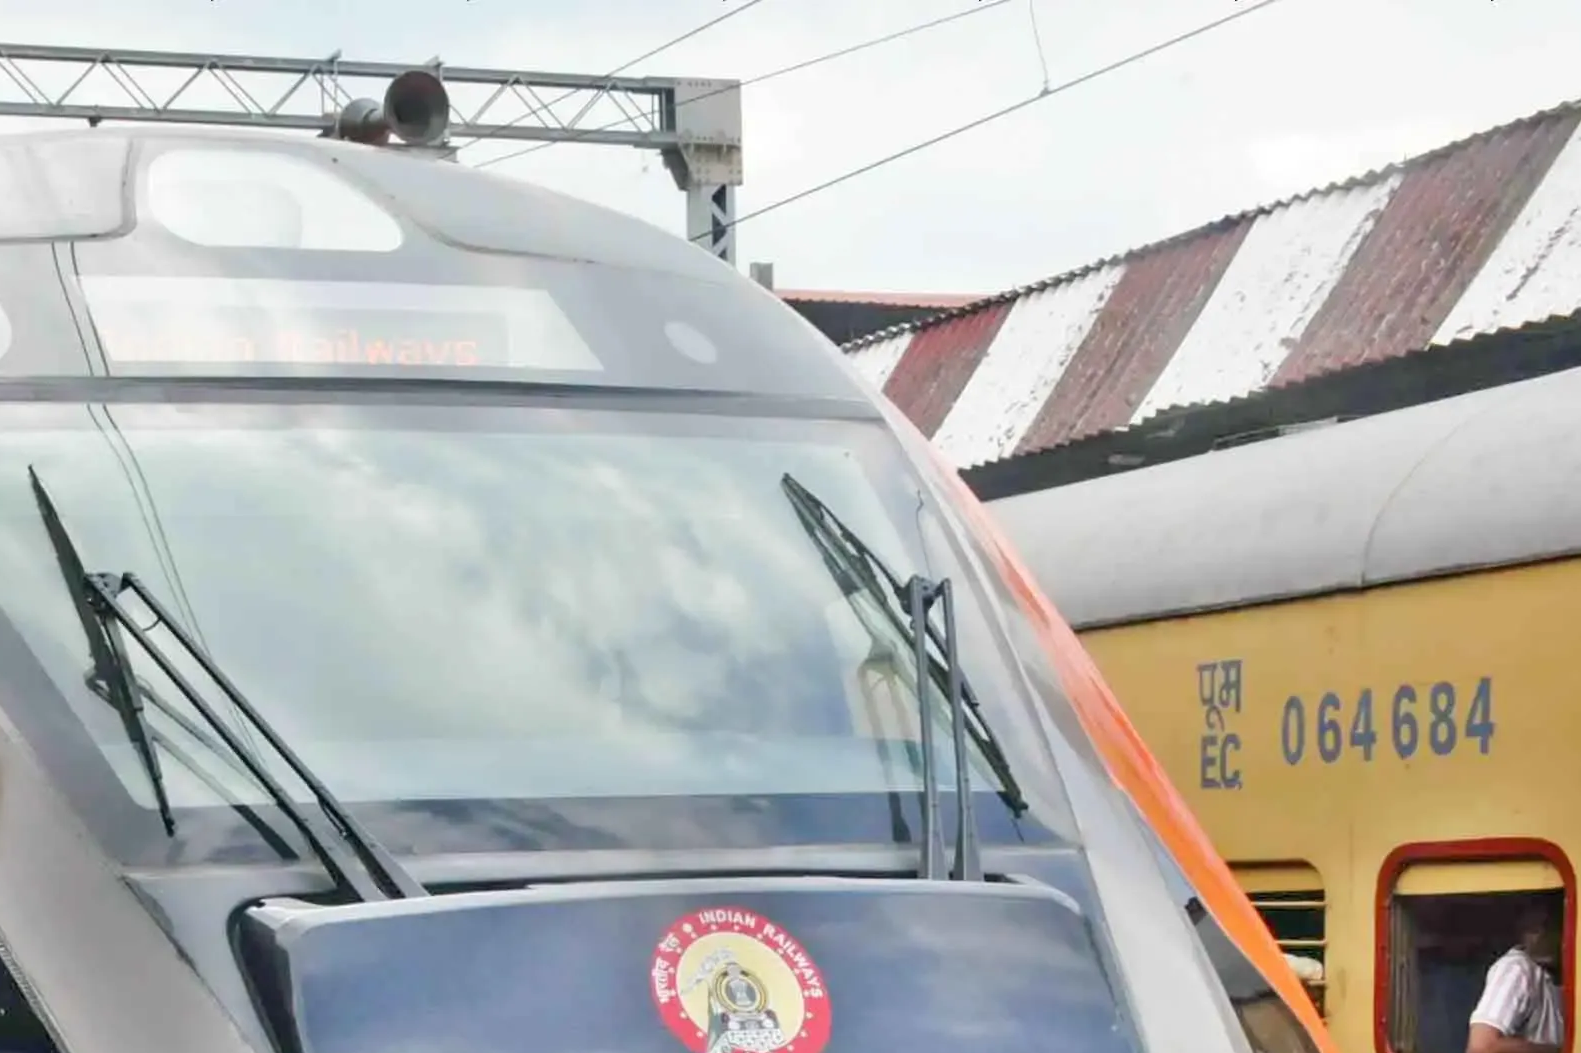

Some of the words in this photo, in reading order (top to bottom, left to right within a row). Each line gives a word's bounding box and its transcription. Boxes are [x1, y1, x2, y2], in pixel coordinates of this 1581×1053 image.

[1200, 733, 1242, 789] EC
[1281, 676, 1495, 765] 064684
[699, 909, 756, 928] INDIAN
[763, 923, 823, 998] RAILWAYS
